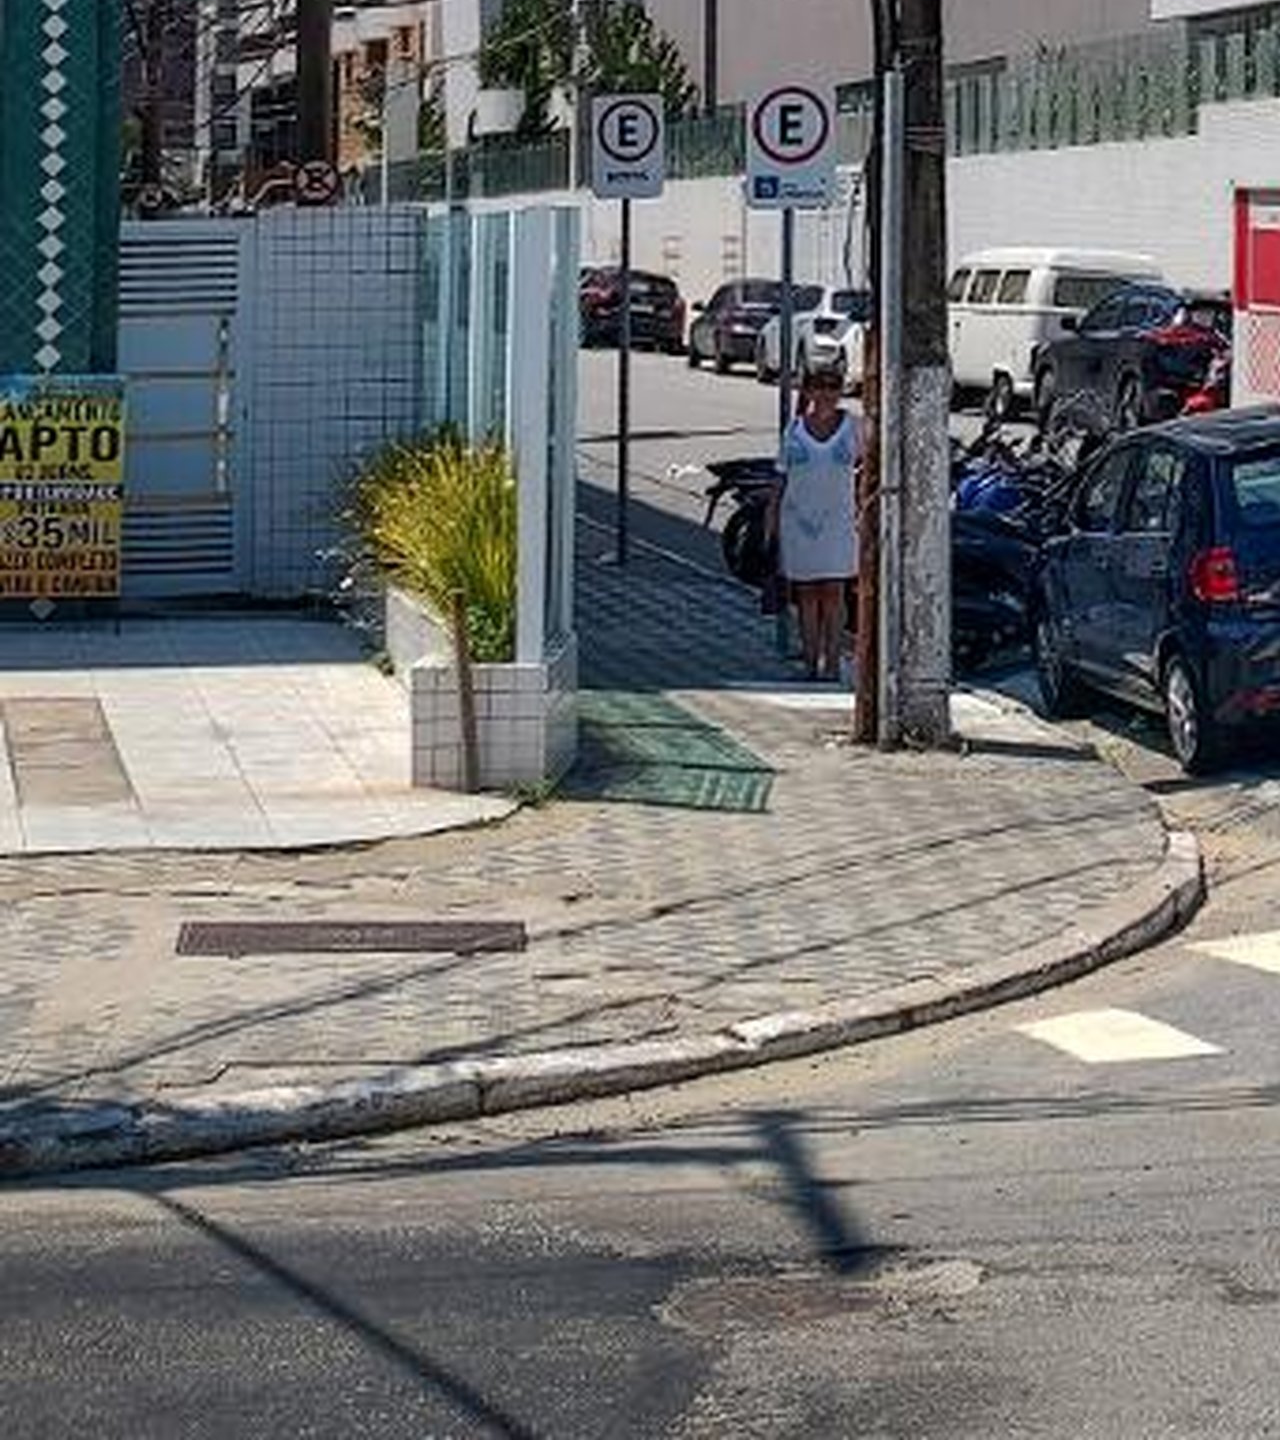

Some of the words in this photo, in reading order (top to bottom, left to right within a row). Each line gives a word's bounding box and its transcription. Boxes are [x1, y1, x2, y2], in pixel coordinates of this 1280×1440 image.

[618, 113, 639, 147] E
[778, 104, 804, 147] E
[0, 426, 120, 462] APTO
[69, 522, 116, 546] MIL
